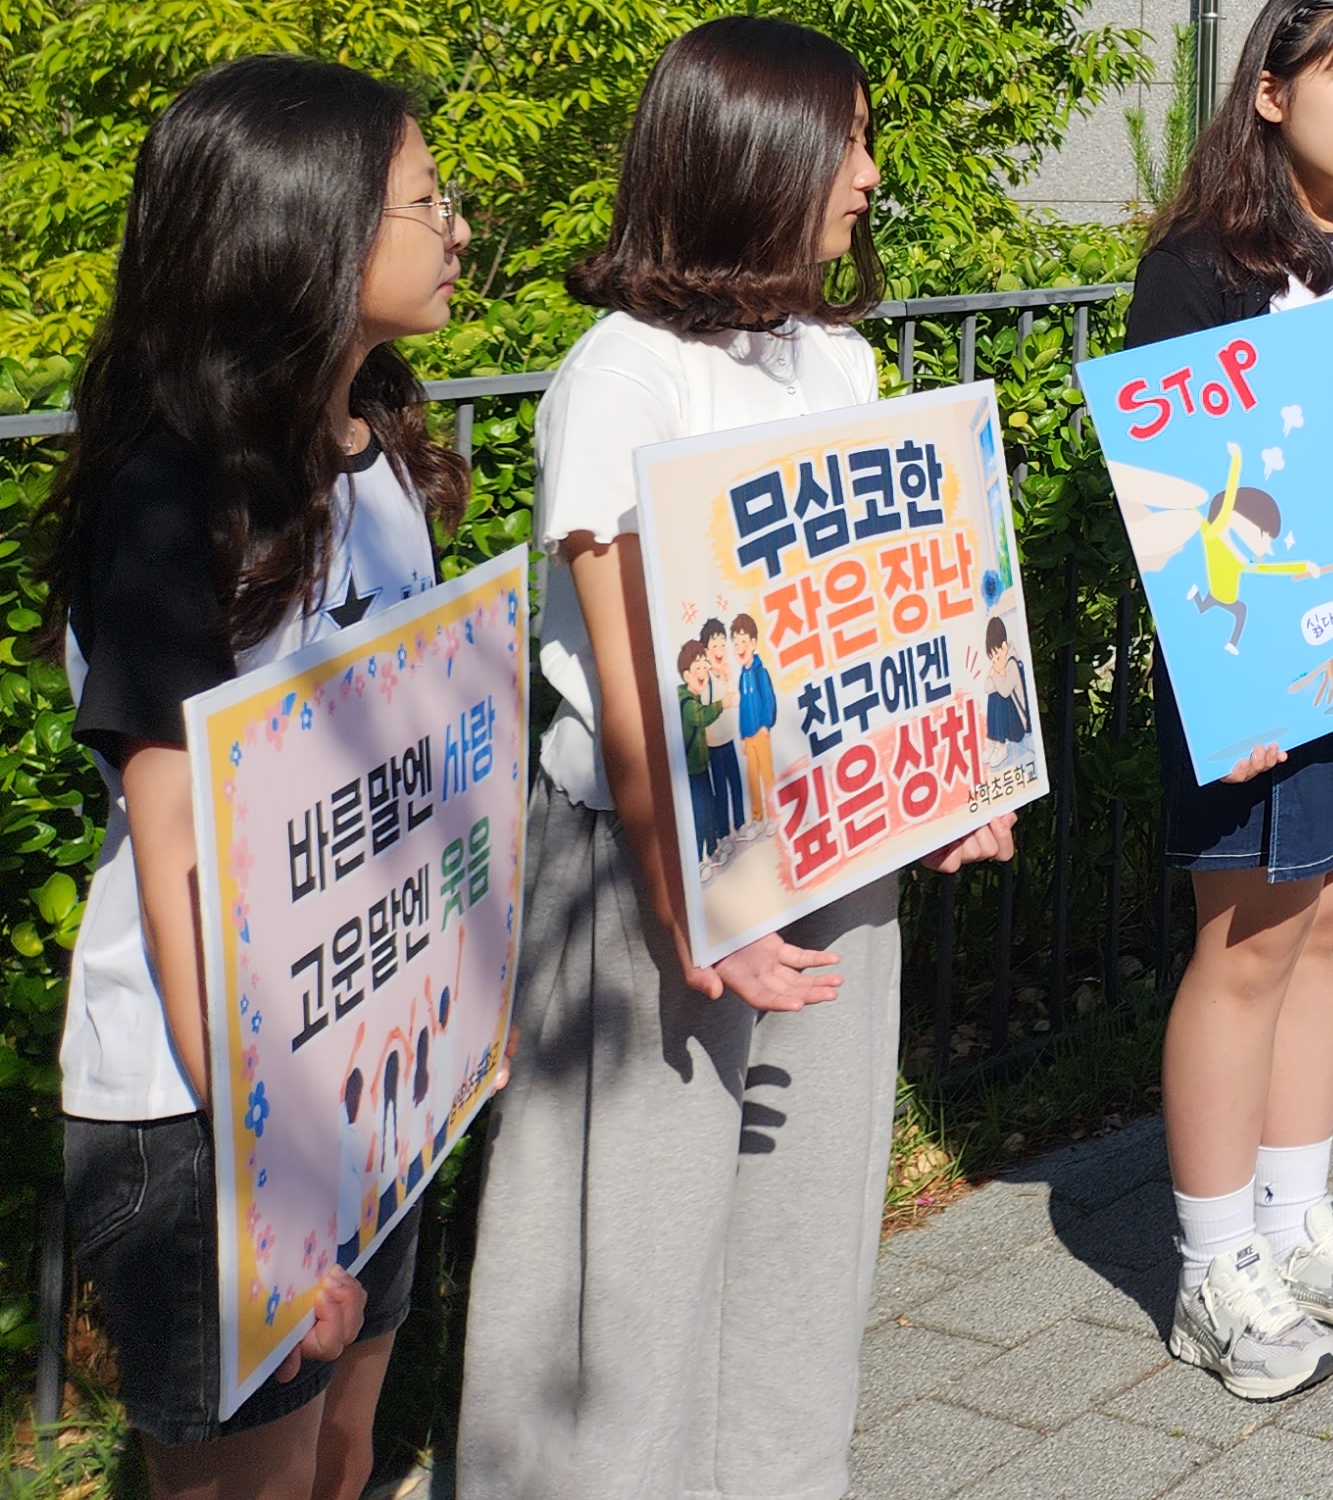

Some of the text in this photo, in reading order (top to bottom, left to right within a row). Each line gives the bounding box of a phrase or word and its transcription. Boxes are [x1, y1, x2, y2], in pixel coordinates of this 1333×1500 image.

[1116, 338, 1260, 441] STOP
[728, 440, 944, 579] 무심코한
[764, 532, 975, 672] 작은 장난
[798, 636, 951, 759] 친구에겐
[288, 695, 496, 904] 바른말엔 사랑
[777, 698, 983, 882] 깊은 상처
[966, 762, 1038, 813] 상학초등학교
[291, 816, 491, 1054] 고운말엔 웃음
